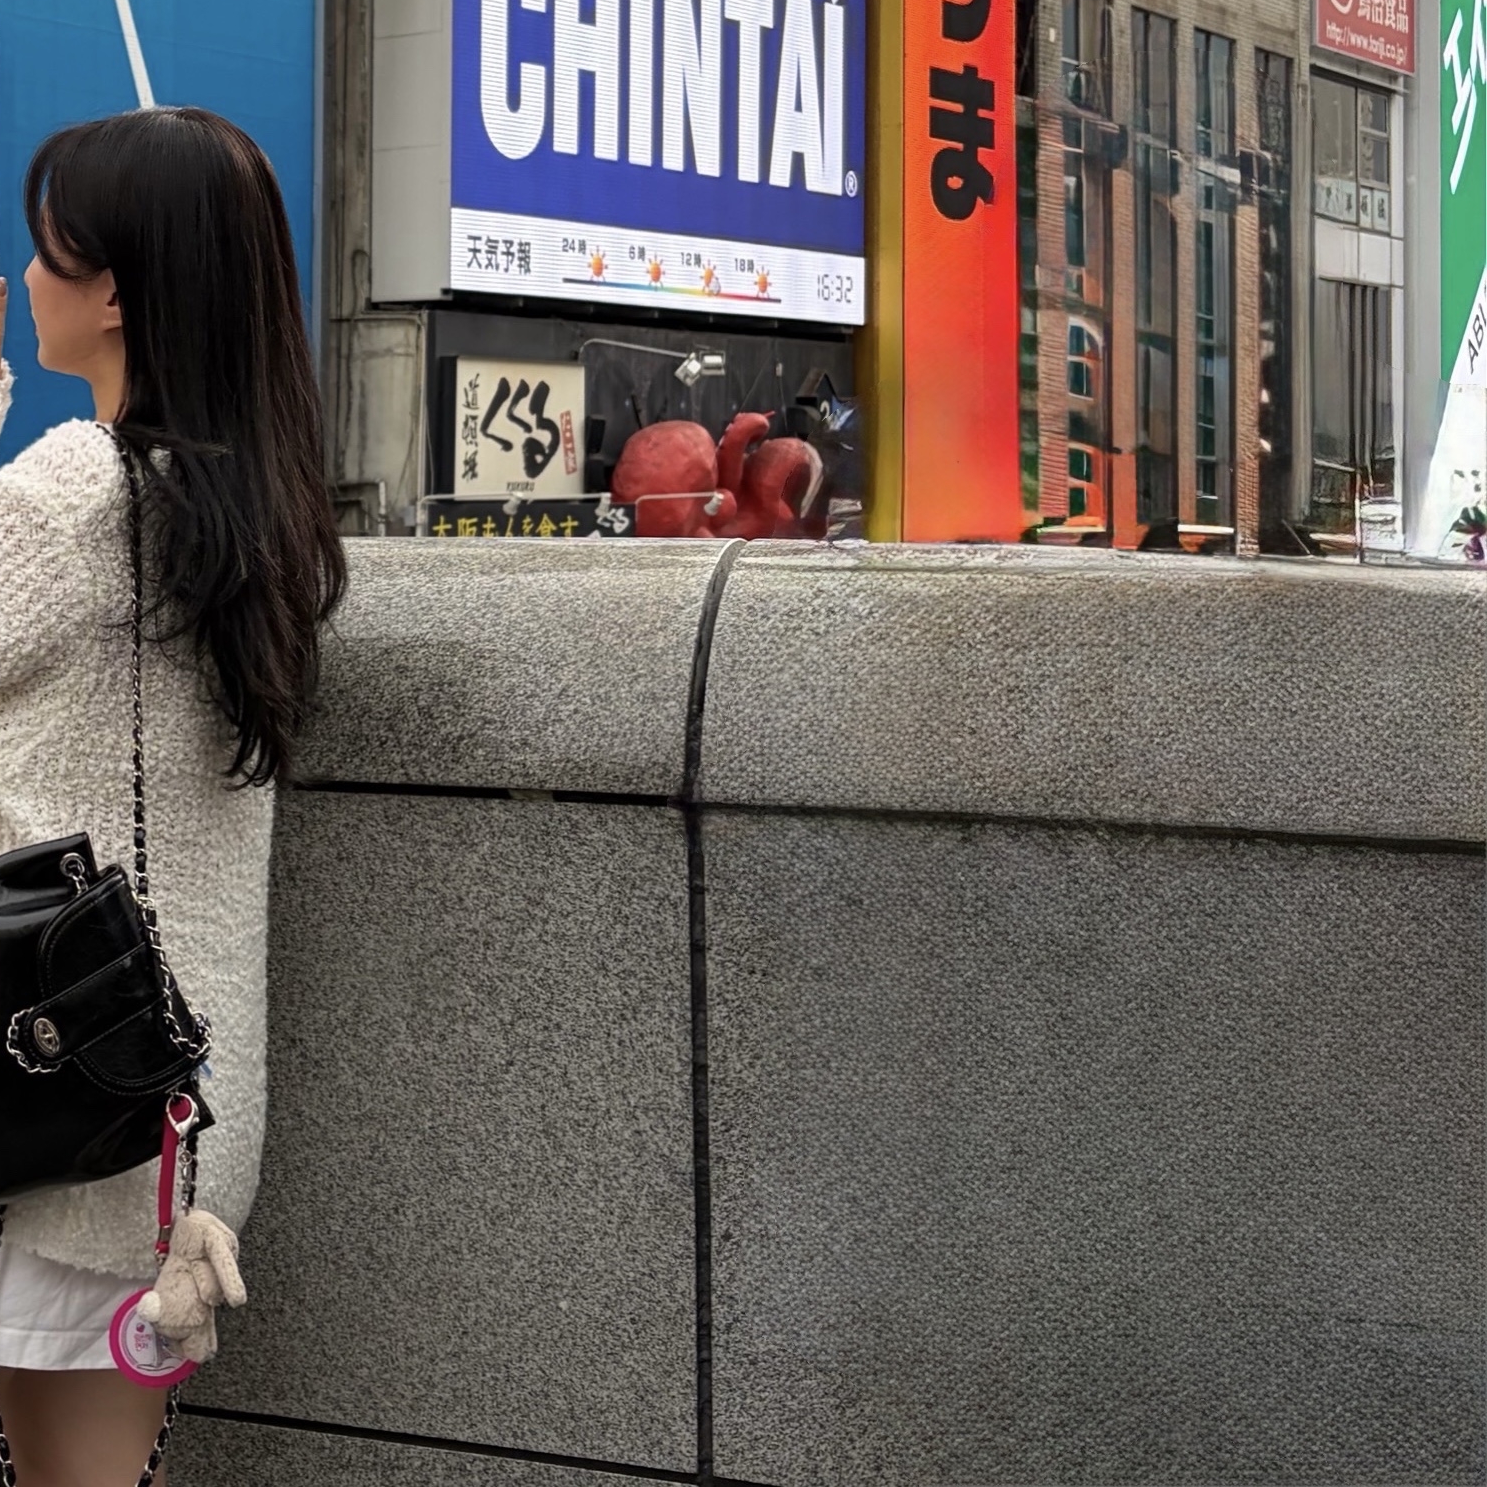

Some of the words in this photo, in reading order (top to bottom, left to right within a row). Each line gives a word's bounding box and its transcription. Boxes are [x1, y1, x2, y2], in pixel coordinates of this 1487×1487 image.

[466, 235, 531, 275] 天気予報
[817, 275, 853, 304] 16:32
[480, 377, 560, 479] くくる
